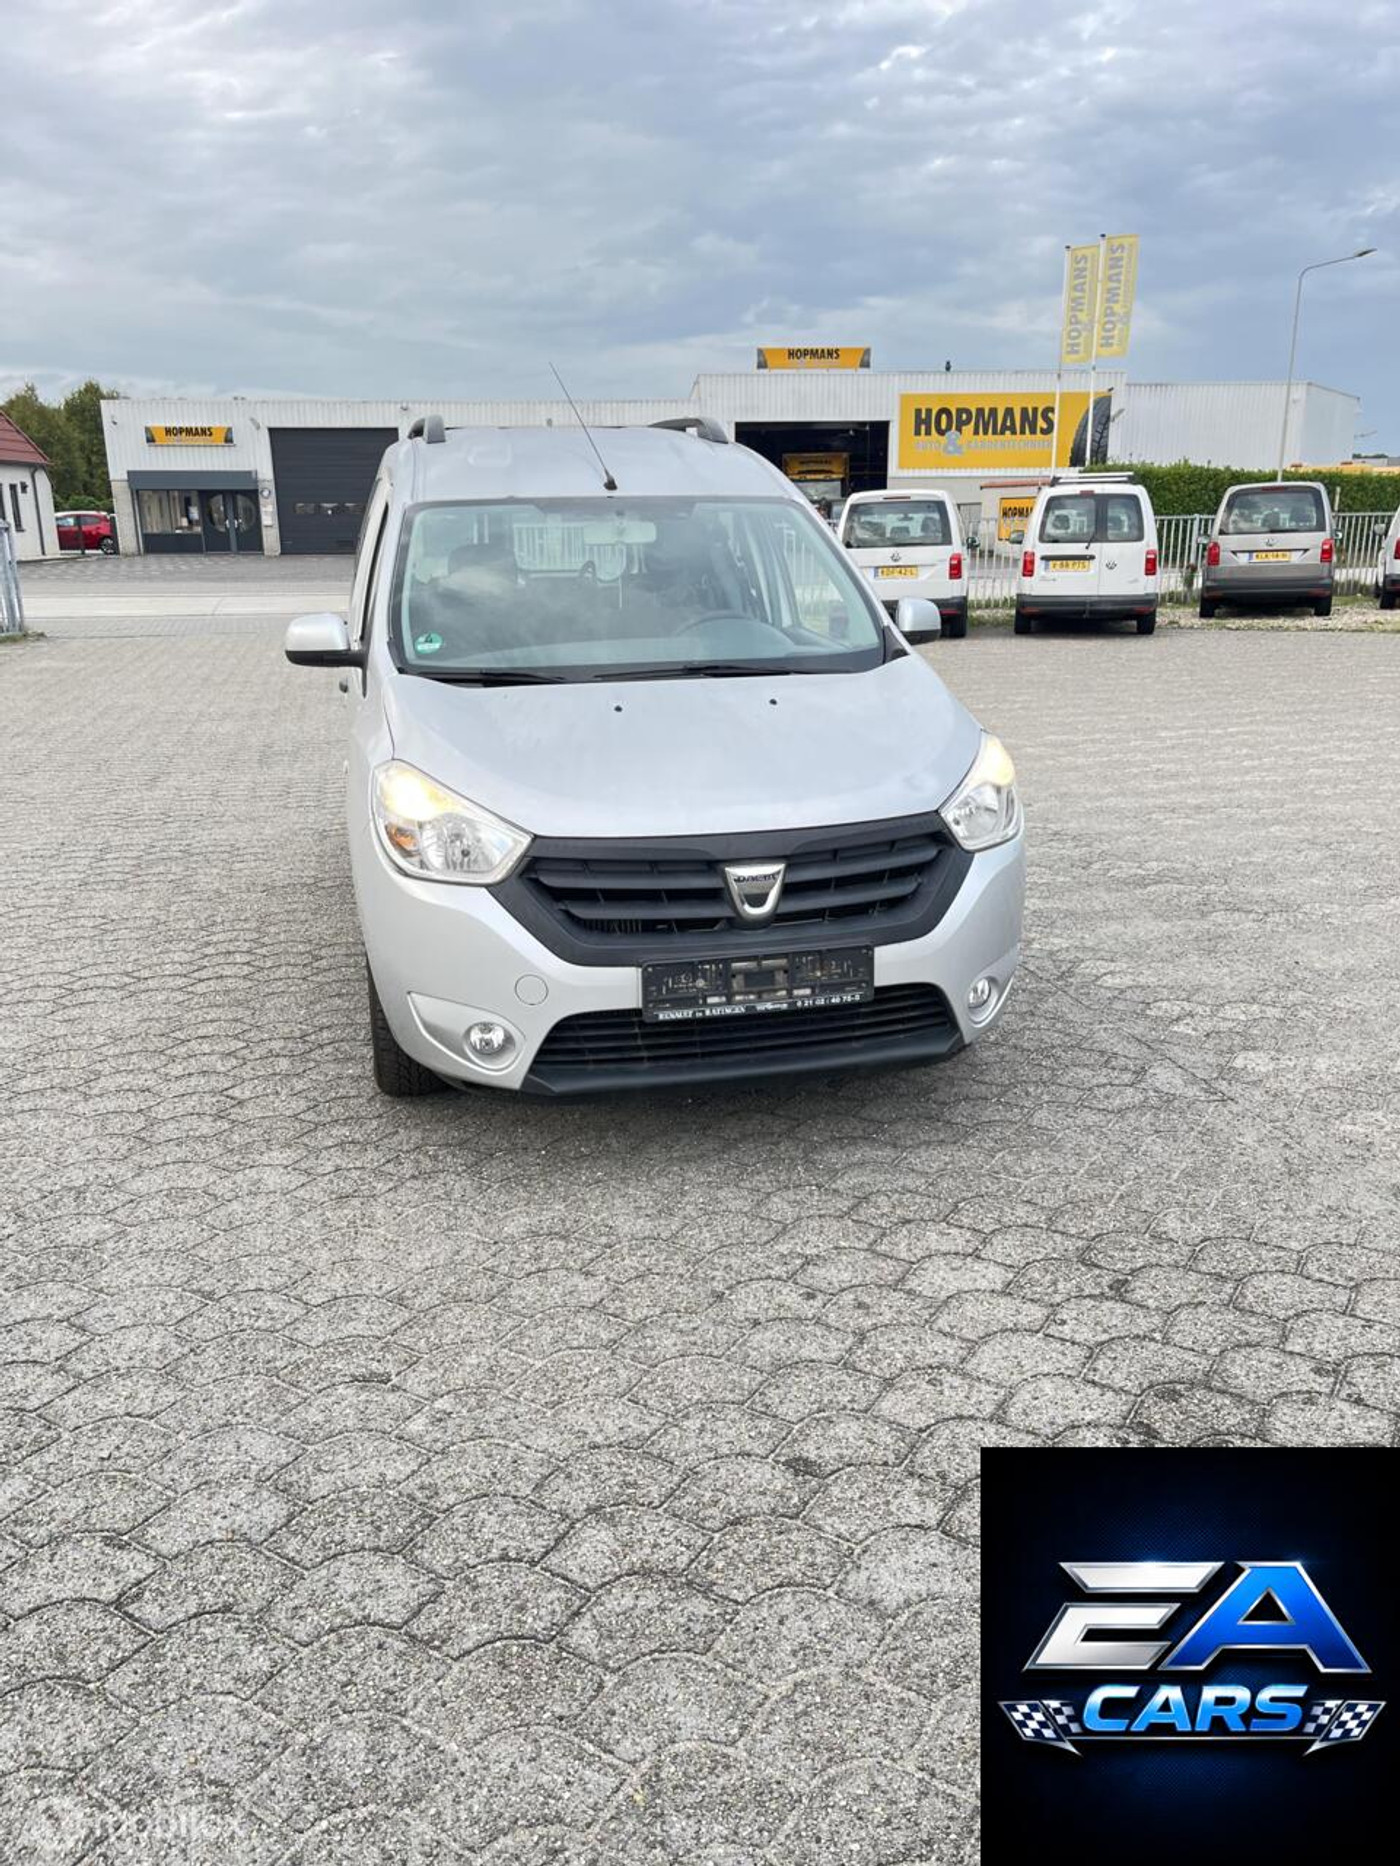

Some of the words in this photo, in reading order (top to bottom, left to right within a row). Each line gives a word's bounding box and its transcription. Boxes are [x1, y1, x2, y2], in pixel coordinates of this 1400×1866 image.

[1066, 254, 1087, 354] HOPMANS
[1101, 244, 1125, 348] HOPMANS
[787, 348, 840, 360] HOPMANS
[165, 427, 213, 437] HOPMANS
[914, 407, 1056, 436] HOPMANS
